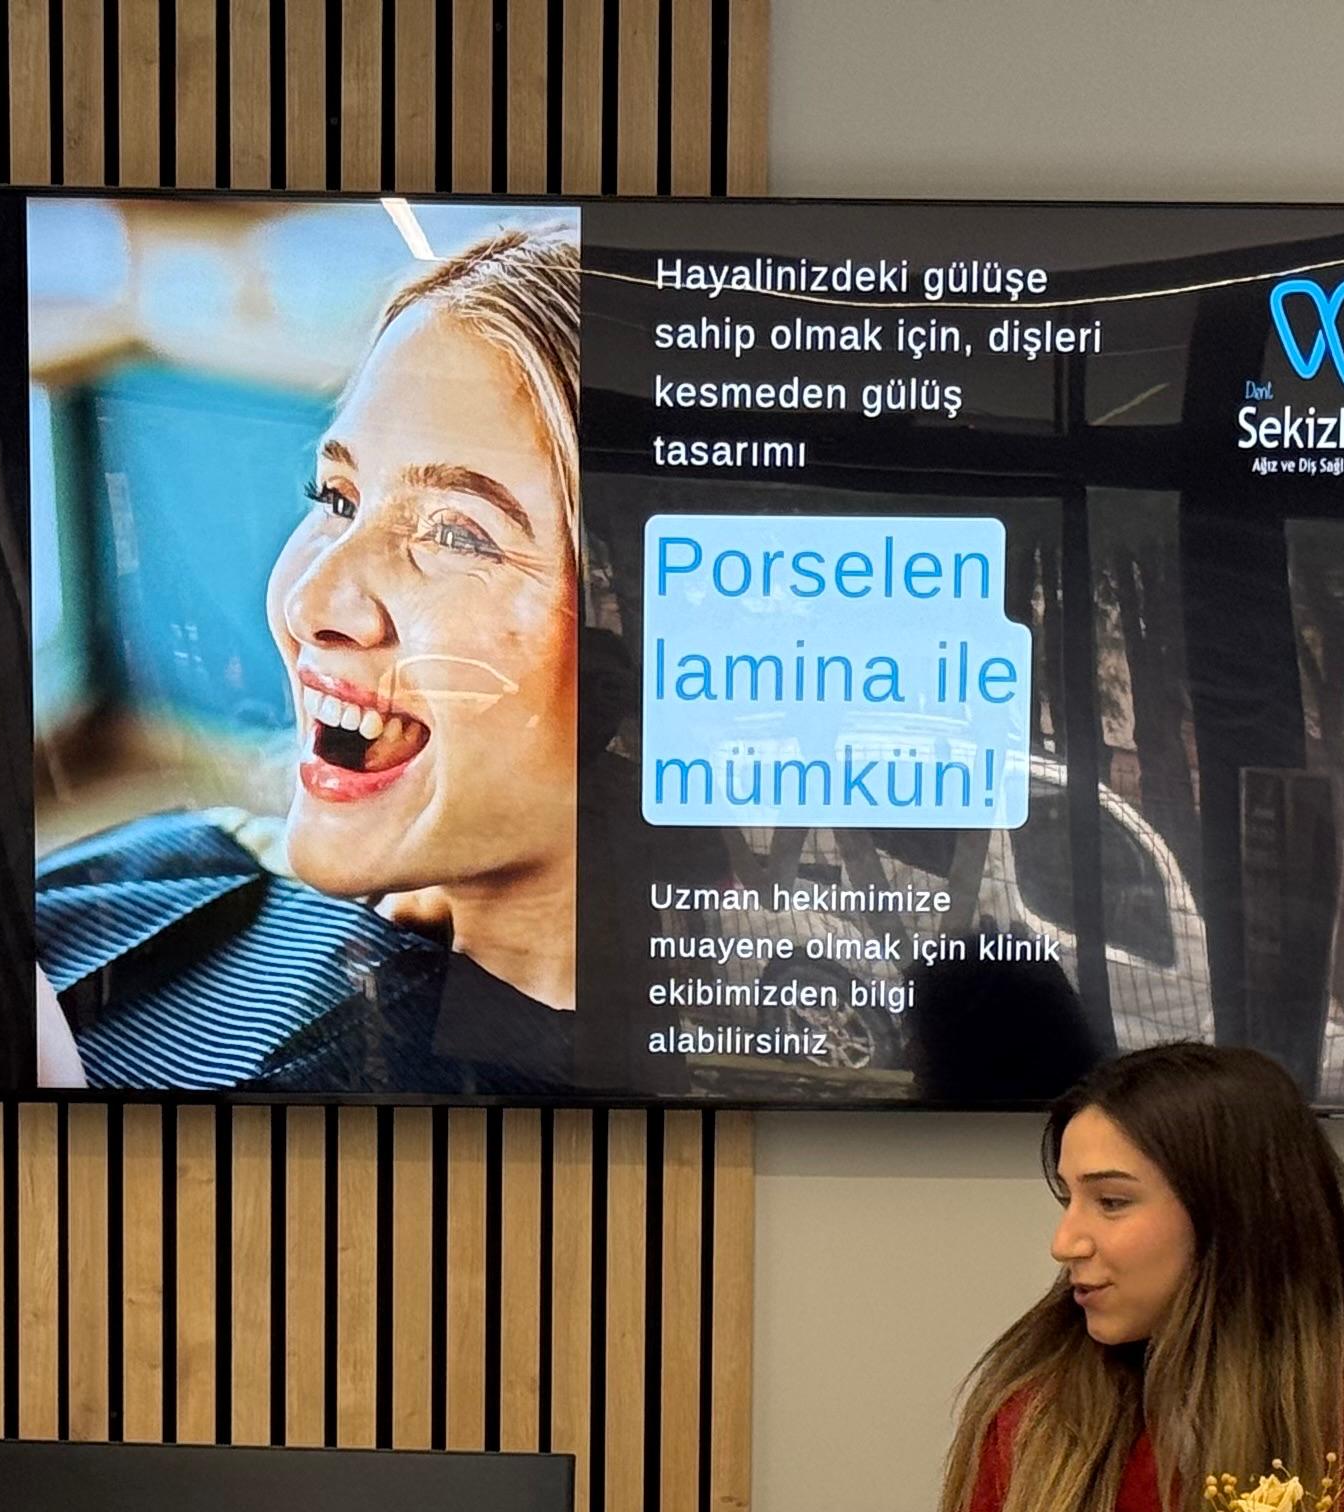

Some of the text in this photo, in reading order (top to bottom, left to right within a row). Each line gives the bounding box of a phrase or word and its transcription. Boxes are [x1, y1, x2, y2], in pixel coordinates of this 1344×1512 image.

[656, 258, 1049, 300] Hayalinizdeki gülüşe
[654, 317, 1103, 361] sahip olmak için, dişleri
[654, 375, 963, 418] kesmeden gülüş
[653, 436, 807, 468] tasarımı
[1251, 457, 1278, 475] Ağız
[1280, 460, 1295, 473] ve
[1298, 457, 1317, 475] Diş
[657, 536, 990, 598] Porselen
[656, 638, 1018, 703] lamina ile
[656, 744, 995, 808] mümkün!
[650, 884, 951, 913] Uzman hekimimize
[649, 932, 1060, 966] muayene olmak için klinik
[648, 978, 915, 1013] ekibimizden bilgi
[648, 1027, 828, 1056] alabilirsiniz
